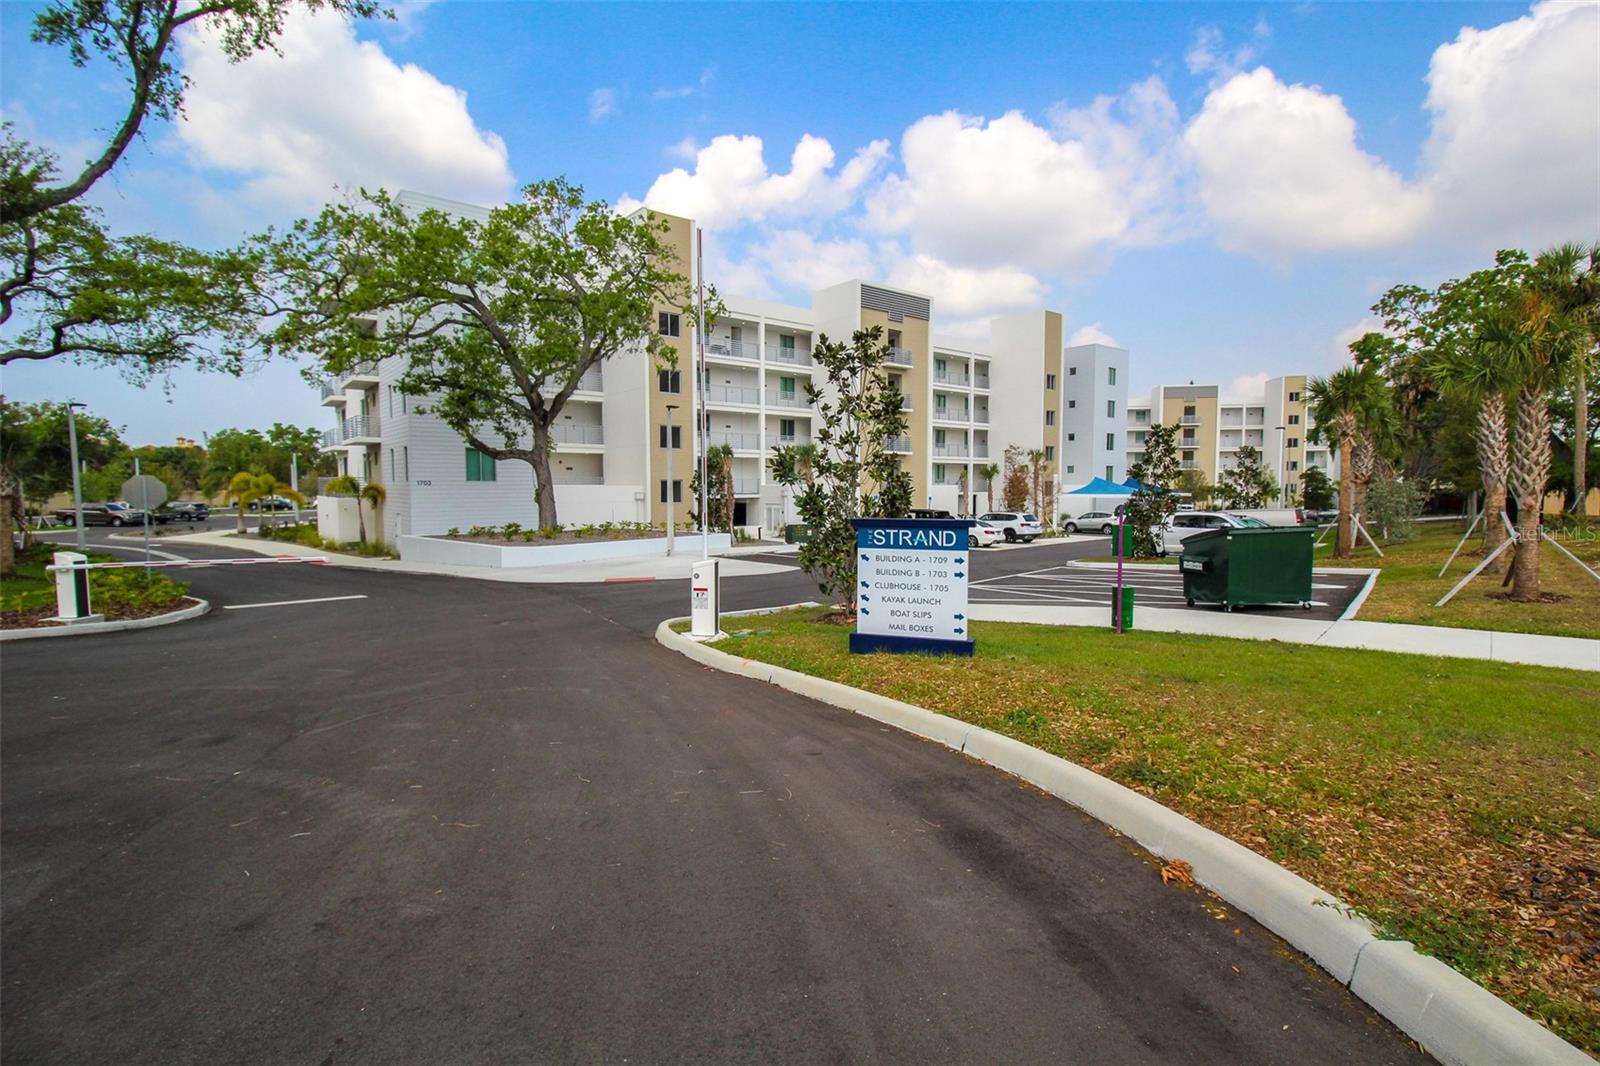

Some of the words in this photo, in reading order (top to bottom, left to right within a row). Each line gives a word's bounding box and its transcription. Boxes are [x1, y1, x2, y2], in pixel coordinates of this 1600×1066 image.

[873, 529, 957, 546] STRAND
[928, 556, 948, 564] 1709
[928, 570, 948, 578] 1703
[874, 582, 921, 591] CLUBHOUSE
[930, 584, 949, 592] 1705
[881, 596, 906, 604] KAYAK
[907, 597, 941, 605] LAUNCH
[912, 611, 932, 619] SLIPS
[909, 625, 934, 633] BOXES
